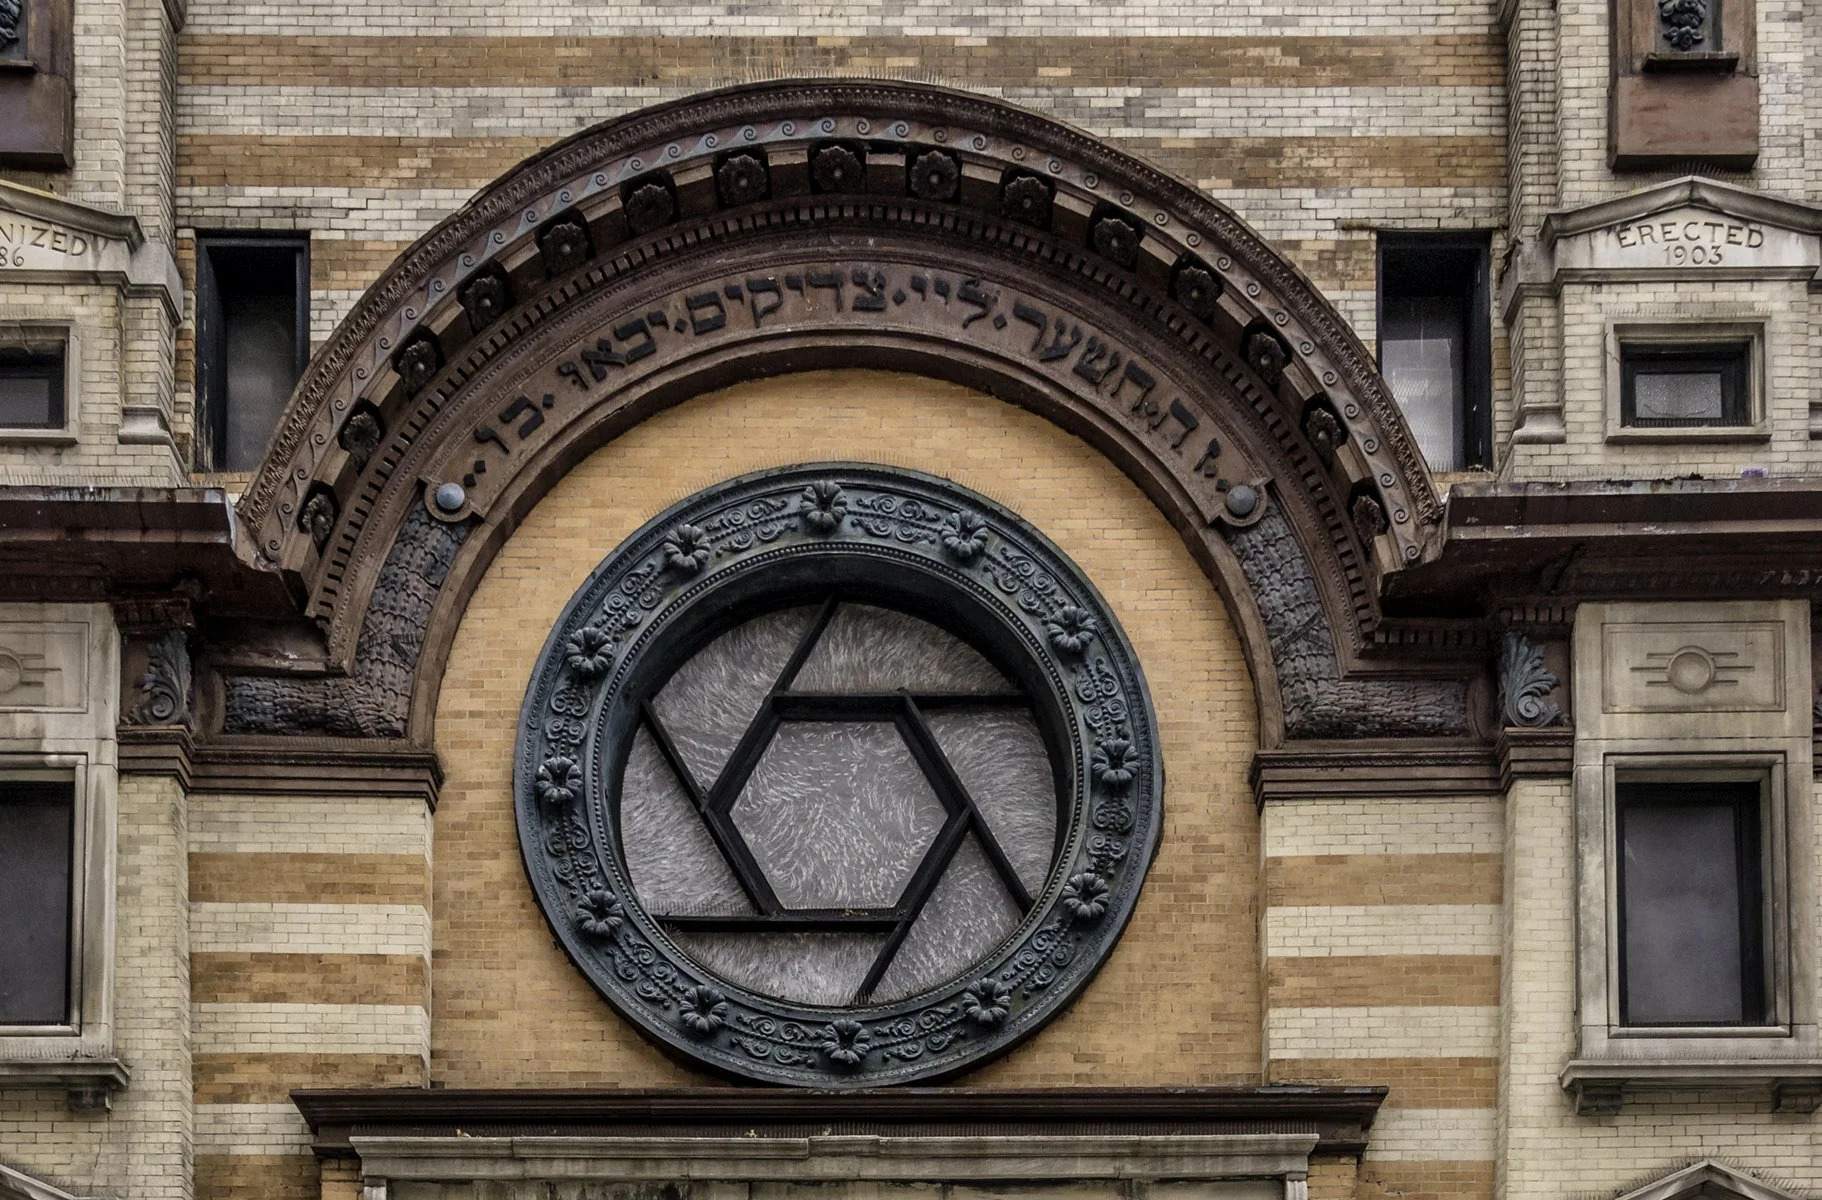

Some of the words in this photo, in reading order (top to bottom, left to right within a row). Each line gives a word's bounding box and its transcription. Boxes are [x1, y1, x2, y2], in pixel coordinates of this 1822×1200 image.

[1617, 221, 1764, 248] ERECTED
[1663, 245, 1723, 265] 1903
[686, 270, 887, 335] צדיקים
[474, 395, 545, 454] בו
